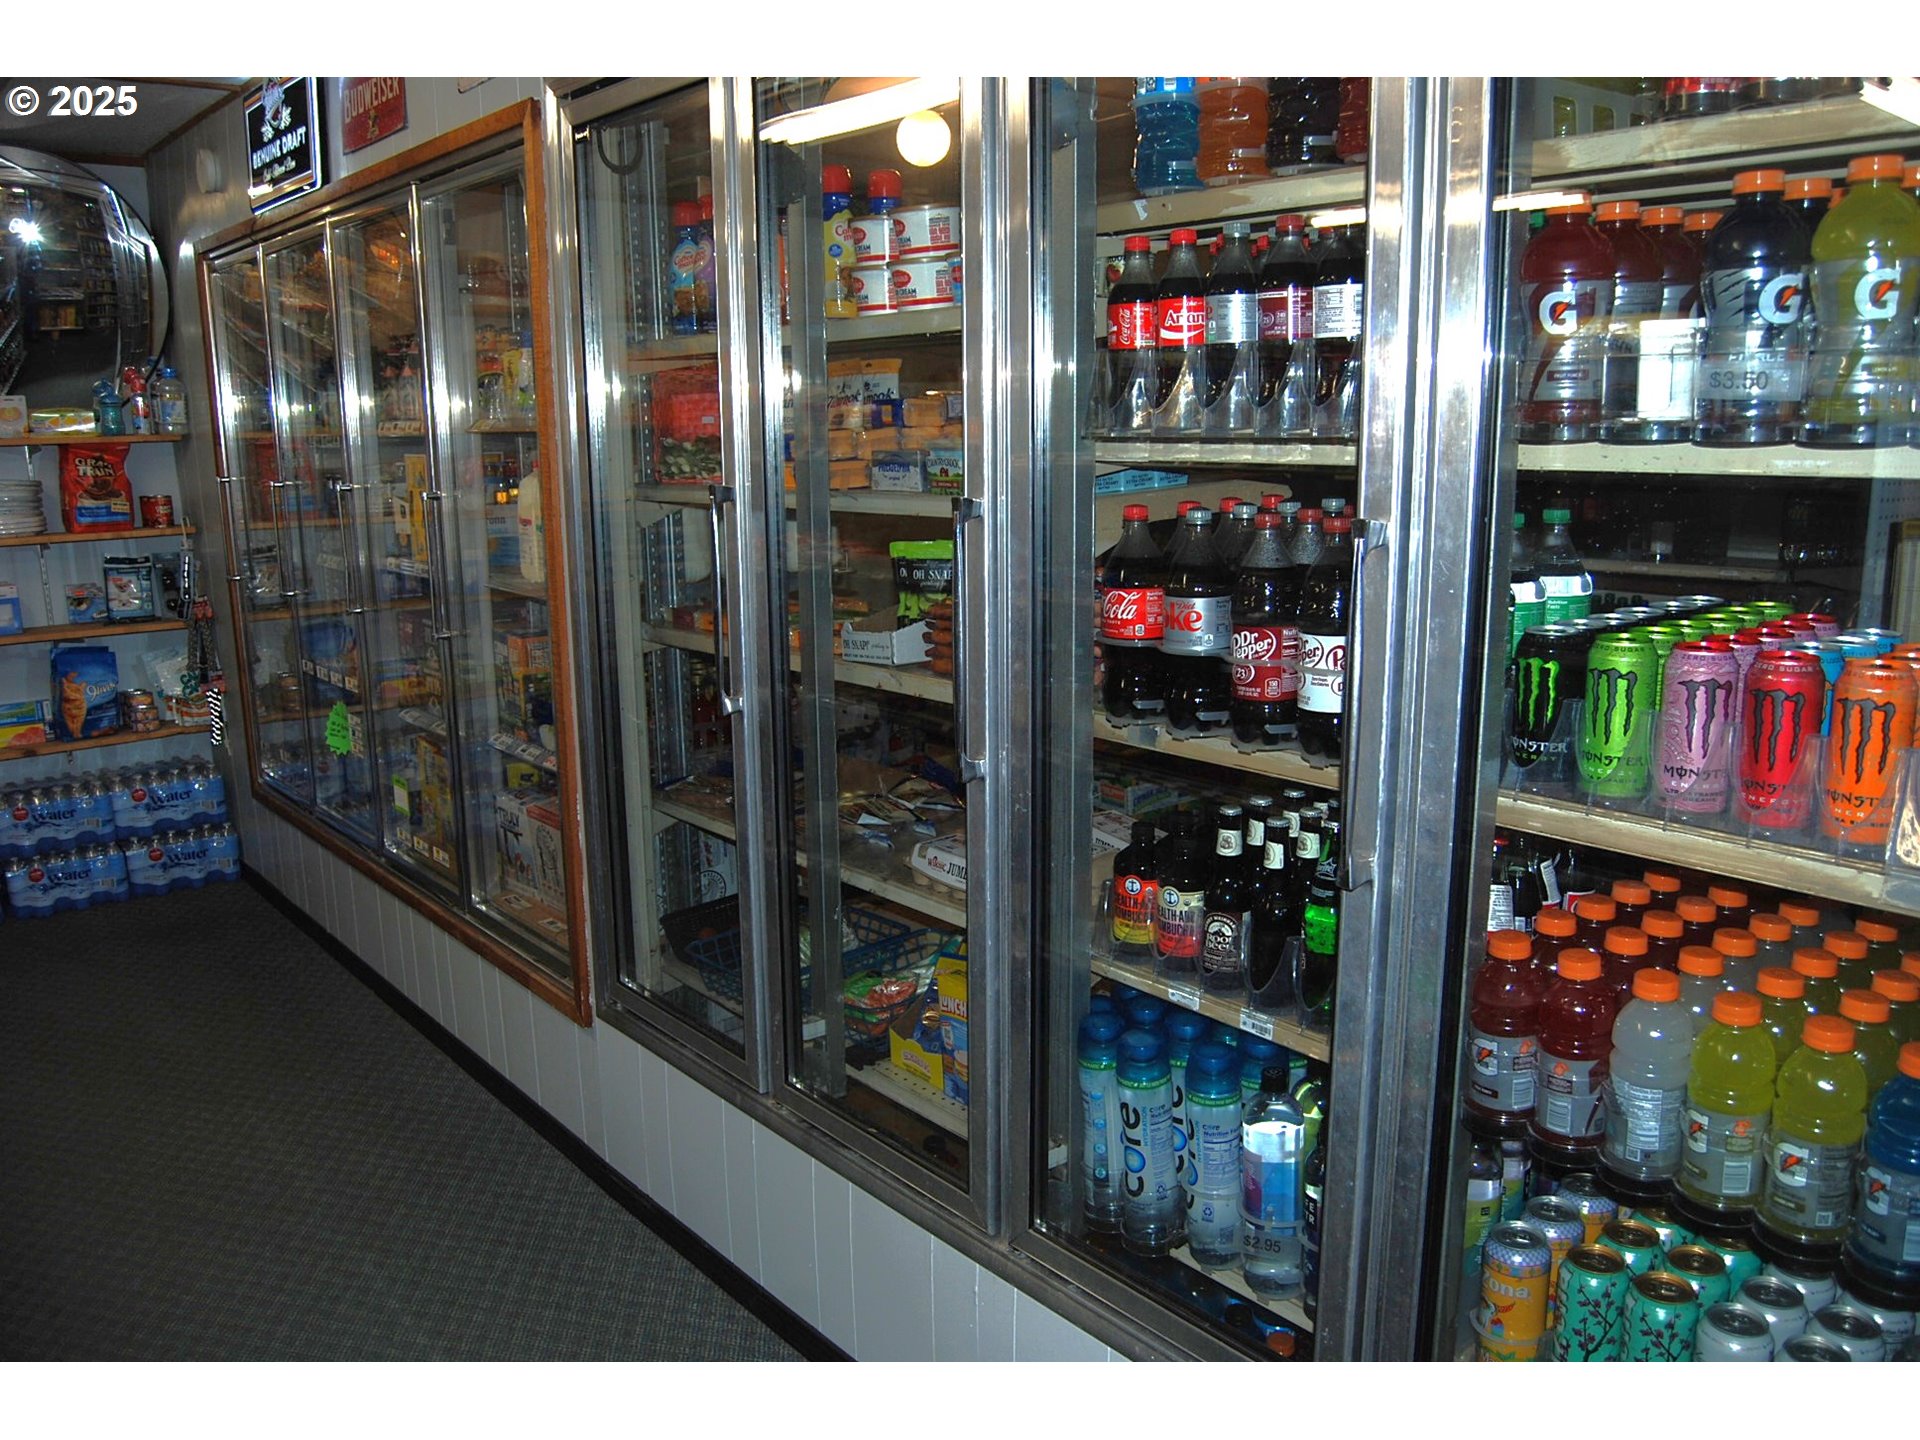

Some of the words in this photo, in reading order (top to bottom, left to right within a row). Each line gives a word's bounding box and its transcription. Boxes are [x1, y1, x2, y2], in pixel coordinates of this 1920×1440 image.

[344, 77, 400, 124] BUDWEISER
[282, 125, 307, 155] DRAFT
[1709, 370, 1769, 390] $3.50
[1103, 590, 1142, 619] Cola
[1232, 634, 1272, 660] Pepper
[1241, 631, 1259, 645] Dr
[1779, 665, 1813, 673] SUGAR
[150, 788, 193, 806] Water
[32, 808, 77, 823] Water
[167, 848, 209, 864] Water
[48, 868, 92, 884] Water
[939, 995, 968, 1018] LUNCH
[1243, 1234, 1282, 1254] $2.95
